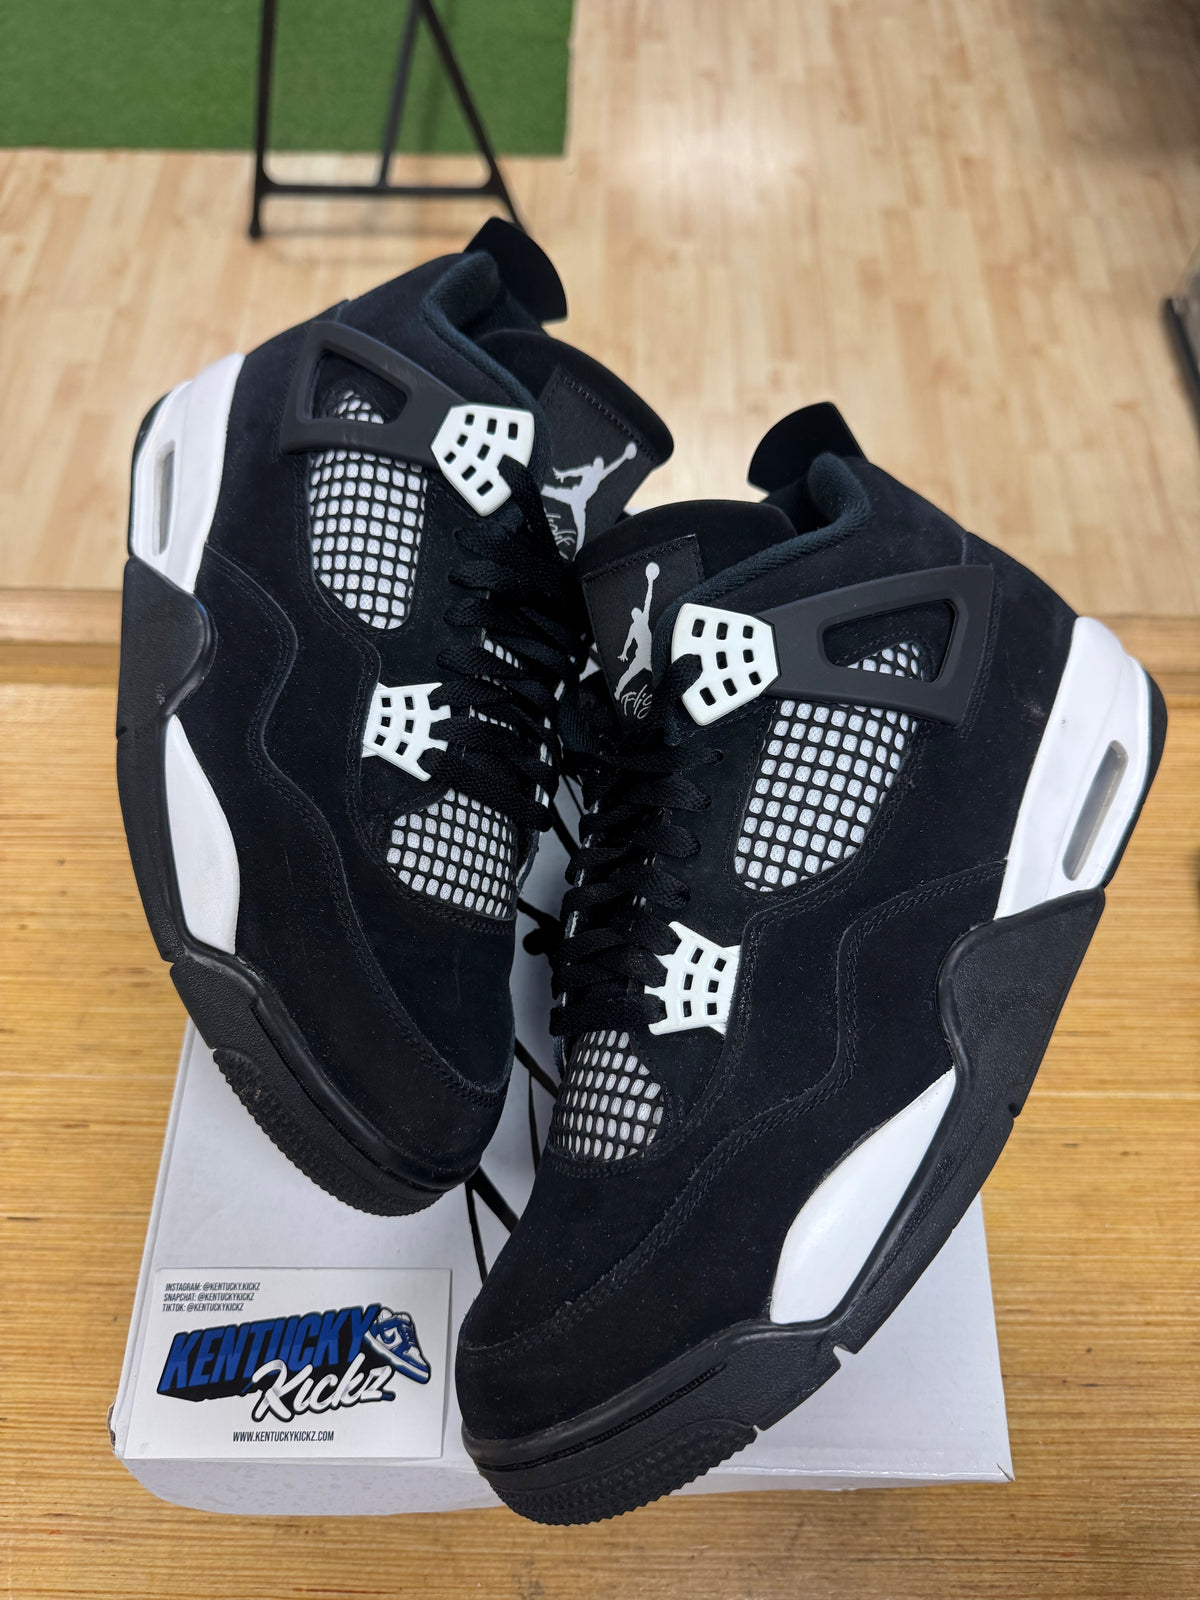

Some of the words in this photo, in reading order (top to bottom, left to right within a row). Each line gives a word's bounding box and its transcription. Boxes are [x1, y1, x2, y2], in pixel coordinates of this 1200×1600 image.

[165, 1282, 202, 1292] INSTAGRAM:
[163, 1292, 197, 1302] SNAPCHAT:
[197, 1291, 255, 1302] @KENTUCKYKICKZ
[162, 1303, 186, 1312] TIKTOK:
[186, 1302, 245, 1312] @KENTUCKYKICKZ
[158, 1304, 381, 1393] KENTUCKY
[251, 1352, 393, 1420] Kickz
[232, 1431, 335, 1442] WWW.KENTUCKYKICKZ.COM
